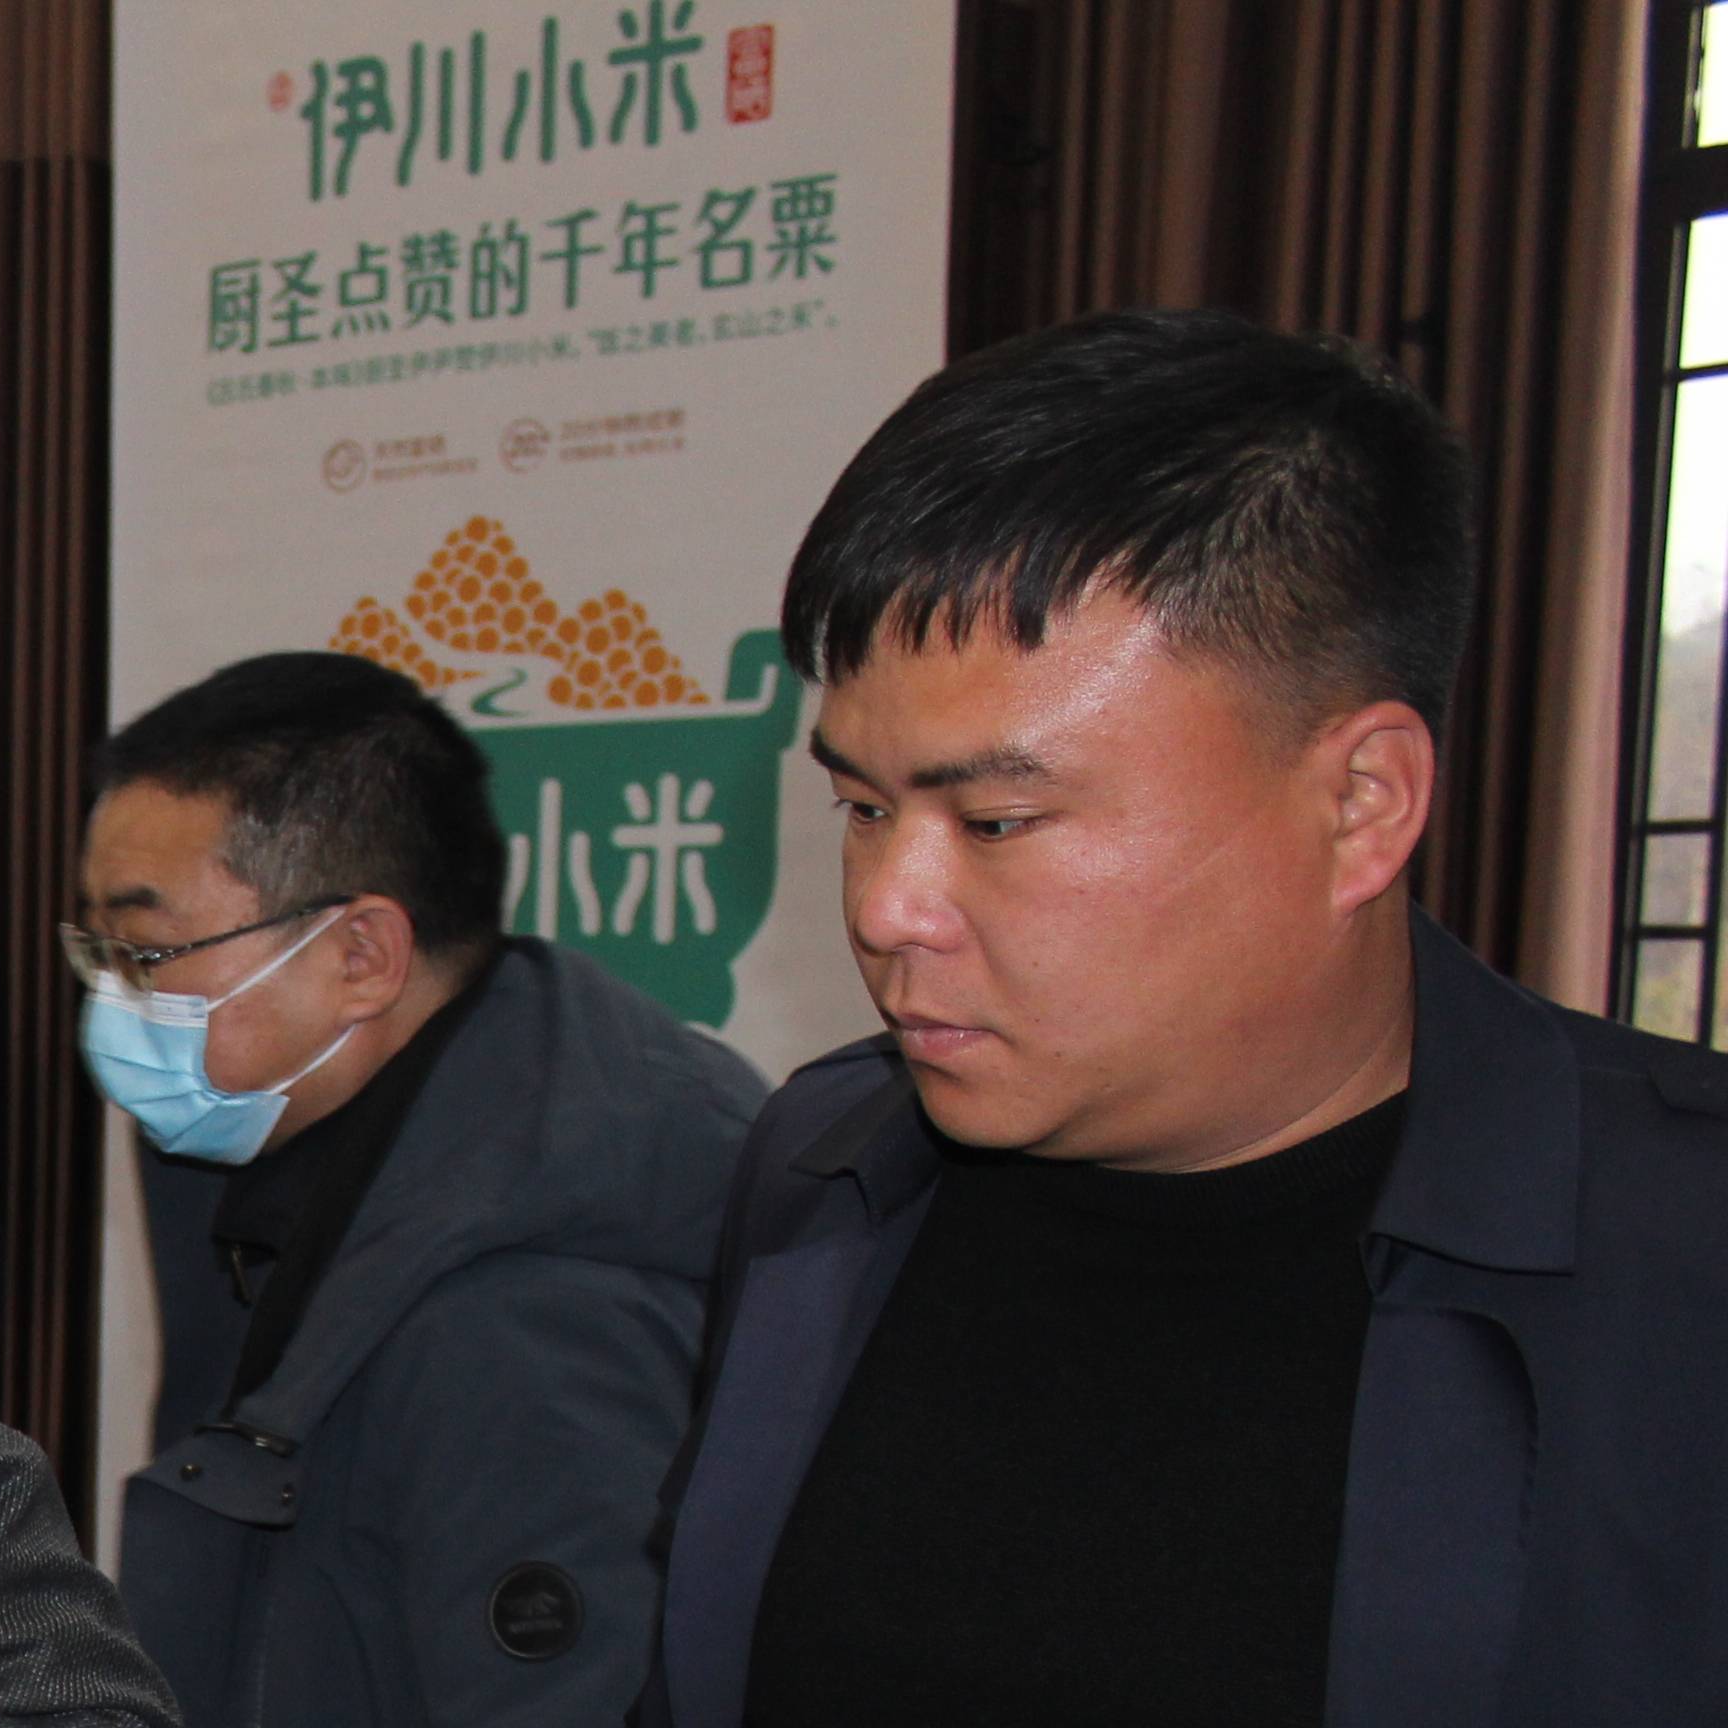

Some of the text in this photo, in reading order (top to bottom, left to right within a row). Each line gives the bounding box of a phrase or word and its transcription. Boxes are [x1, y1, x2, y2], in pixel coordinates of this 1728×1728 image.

[298, 0, 706, 201] 伊川小米
[205, 172, 840, 355] 厨圣点赞的千年名粟
[501, 773, 724, 944] 小米
